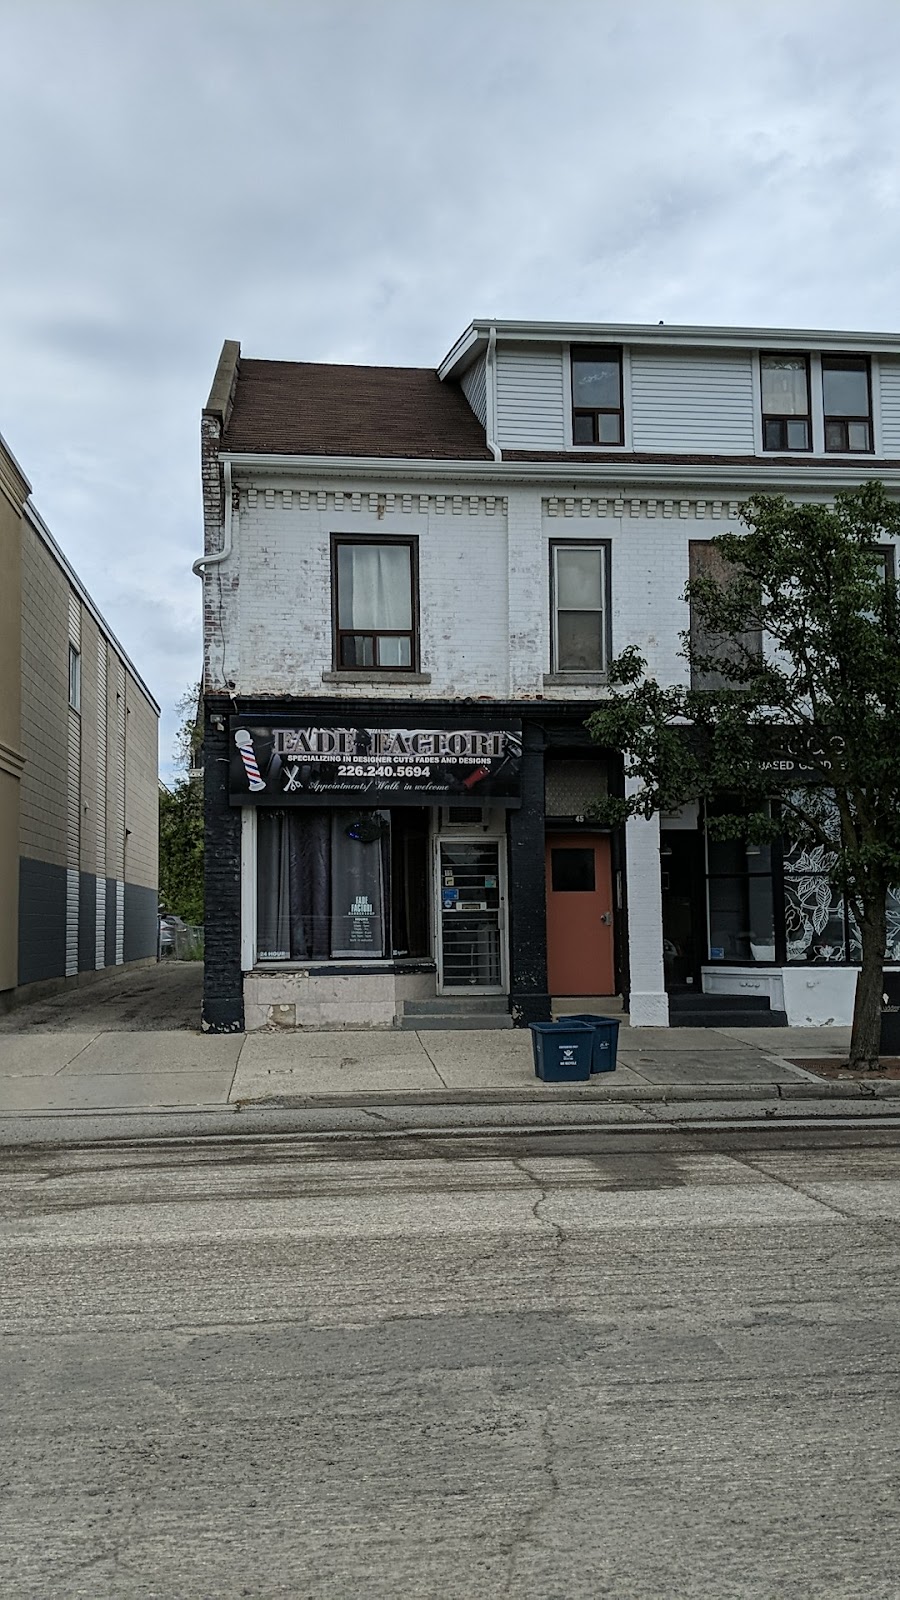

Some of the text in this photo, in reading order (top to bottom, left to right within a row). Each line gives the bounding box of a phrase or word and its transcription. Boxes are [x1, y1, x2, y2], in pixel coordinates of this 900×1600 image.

[272, 729, 357, 756] FADE
[343, 755, 352, 763] IN
[458, 757, 492, 765] DESIGNS
[338, 765, 431, 777] 226.240.5694
[375, 779, 400, 791] Walk
[404, 782, 412, 791] in
[414, 781, 450, 791] welcome
